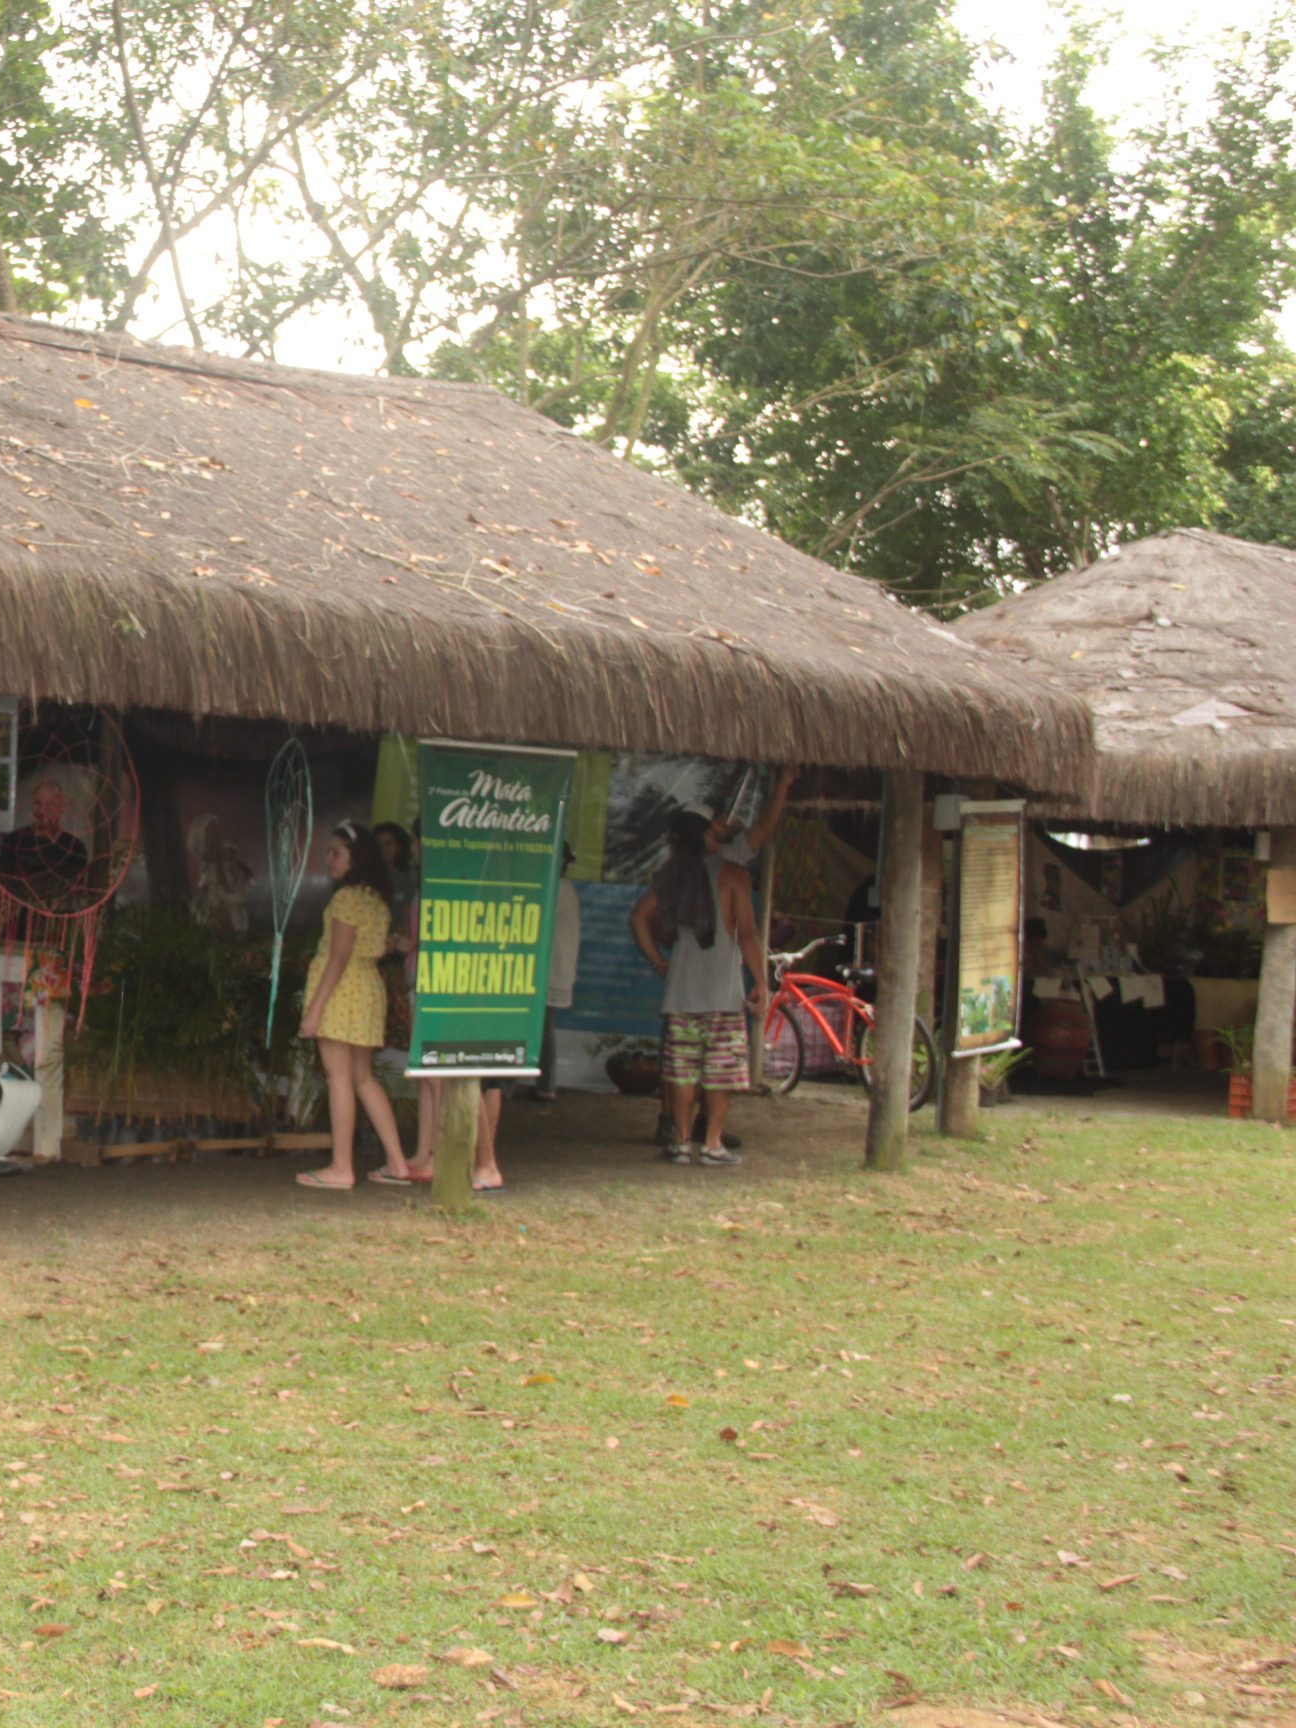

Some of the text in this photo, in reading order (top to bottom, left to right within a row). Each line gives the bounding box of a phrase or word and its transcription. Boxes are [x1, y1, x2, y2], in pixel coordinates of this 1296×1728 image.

[468, 769, 533, 802] Mata
[439, 797, 552, 832] Atlântica
[419, 896, 541, 950] EDUCAÇÃO
[416, 951, 536, 994] AMBIENTAL
